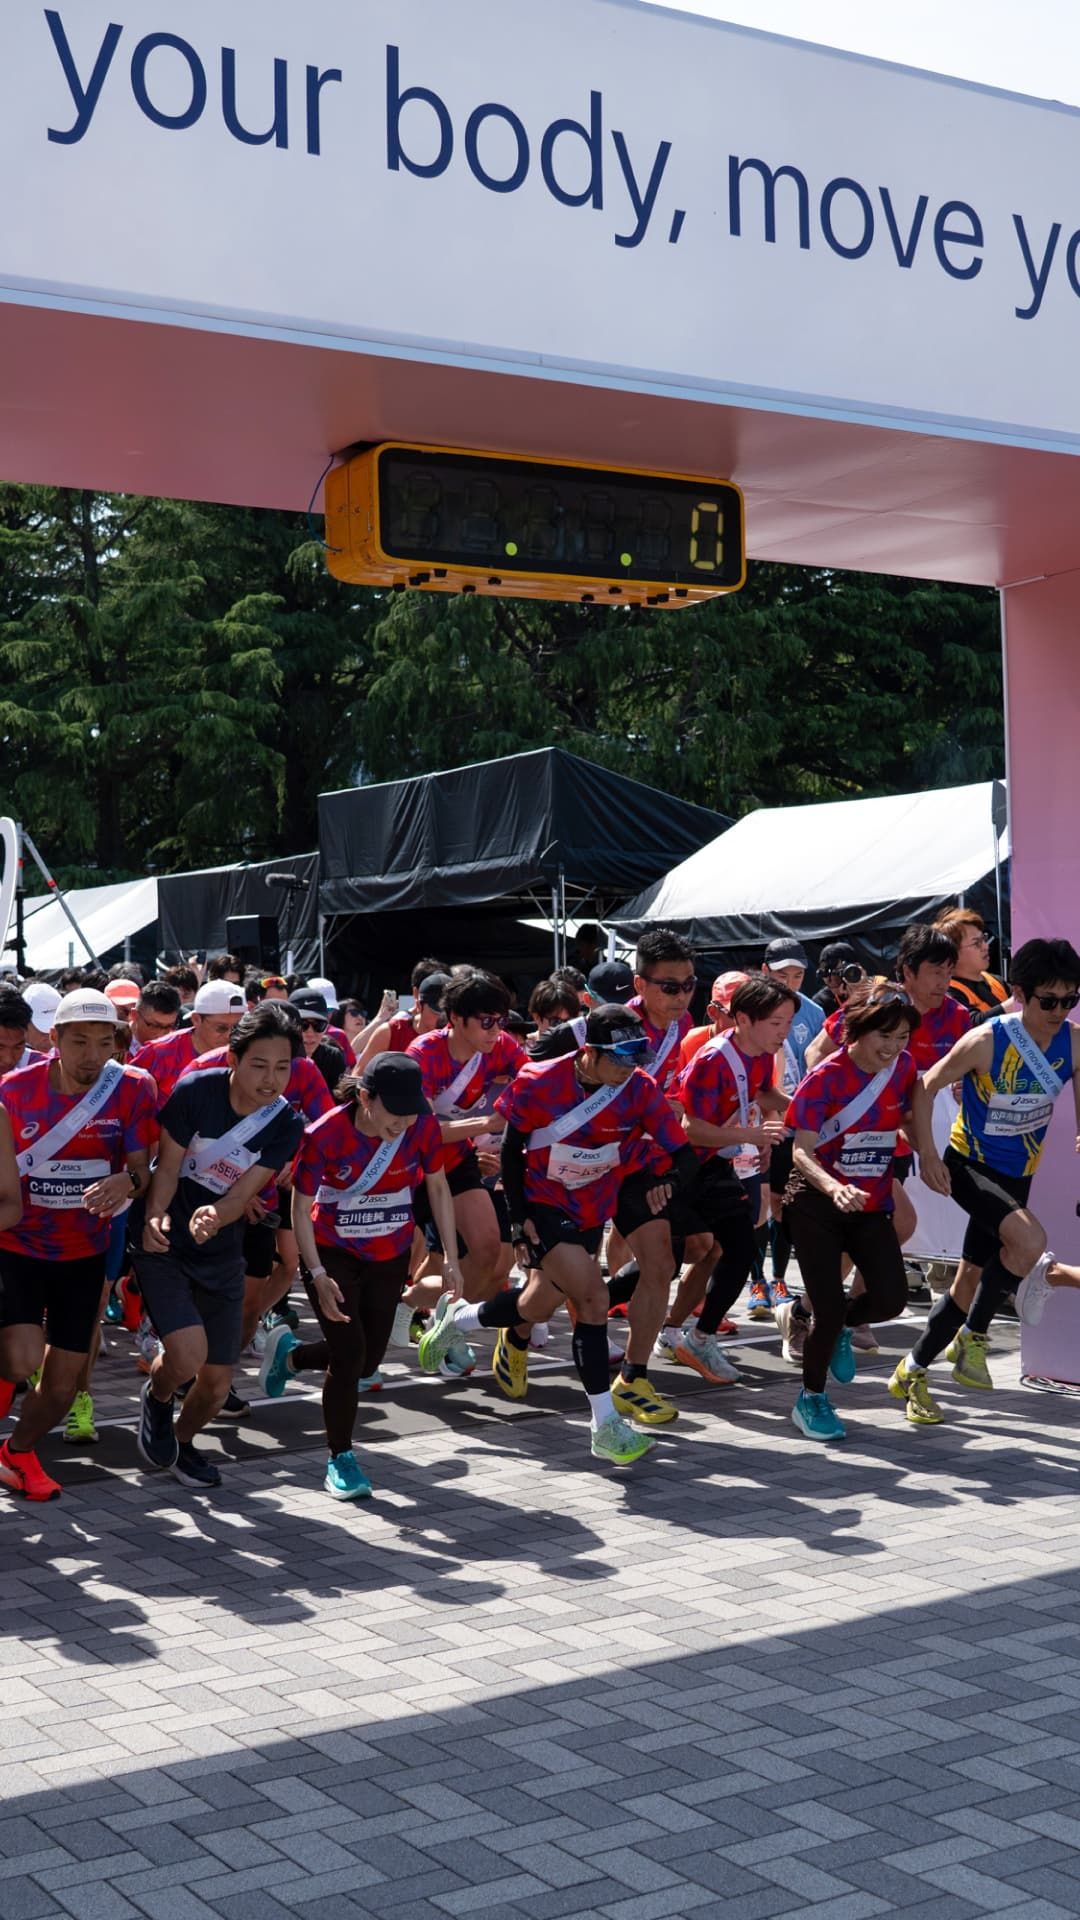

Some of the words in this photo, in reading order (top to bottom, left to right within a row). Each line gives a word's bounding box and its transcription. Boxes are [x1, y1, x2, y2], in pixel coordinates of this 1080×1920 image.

[44, 10, 342, 156] your
[387, 45, 686, 249] body,
[729, 156, 984, 281] move
[1012, 214, 1080, 320] y
[690, 502, 723, 571] 0
[88, 1082, 110, 1106] move
[584, 1096, 606, 1114] move
[30, 1181, 85, 1195] C-Project
